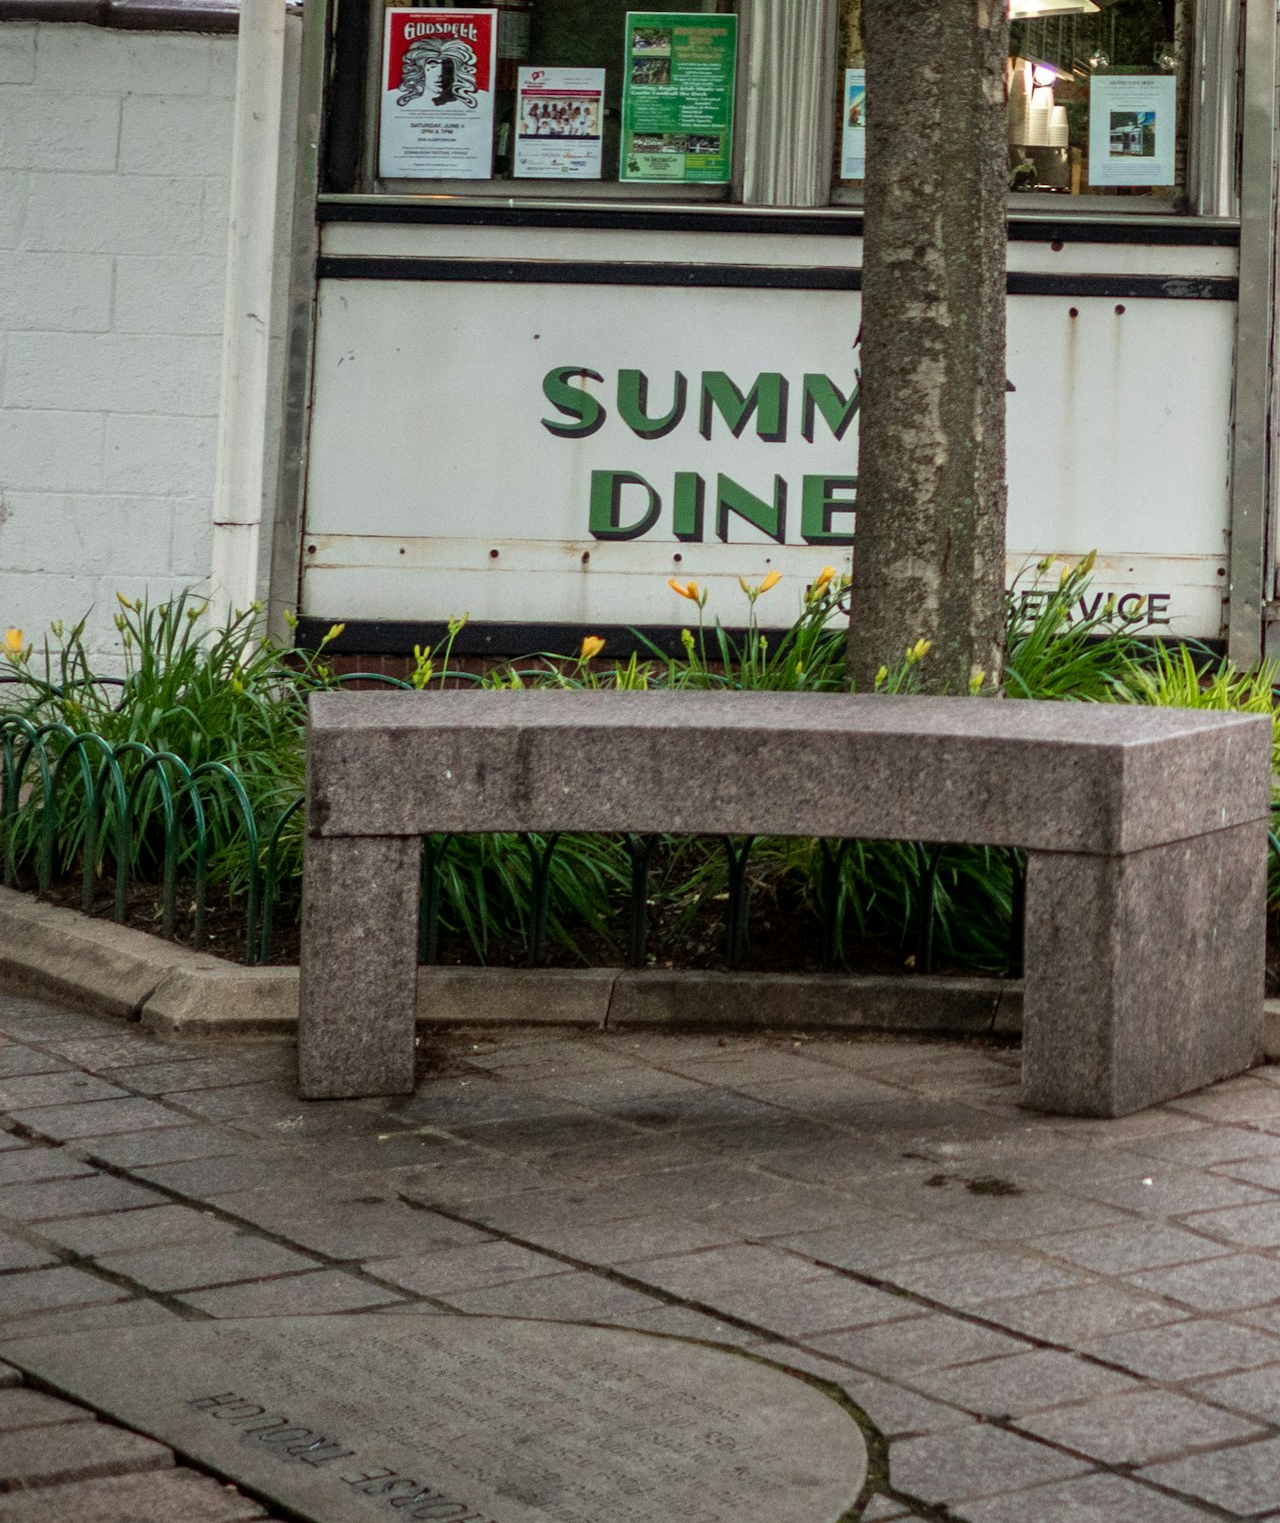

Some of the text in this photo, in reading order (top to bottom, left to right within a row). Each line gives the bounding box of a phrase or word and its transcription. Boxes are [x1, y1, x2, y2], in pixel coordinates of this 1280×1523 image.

[403, 22, 478, 43] GODSPELL
[541, 366, 861, 444] SUMM
[588, 469, 859, 545] DINE
[185, 1390, 358, 1468] TROUGH
